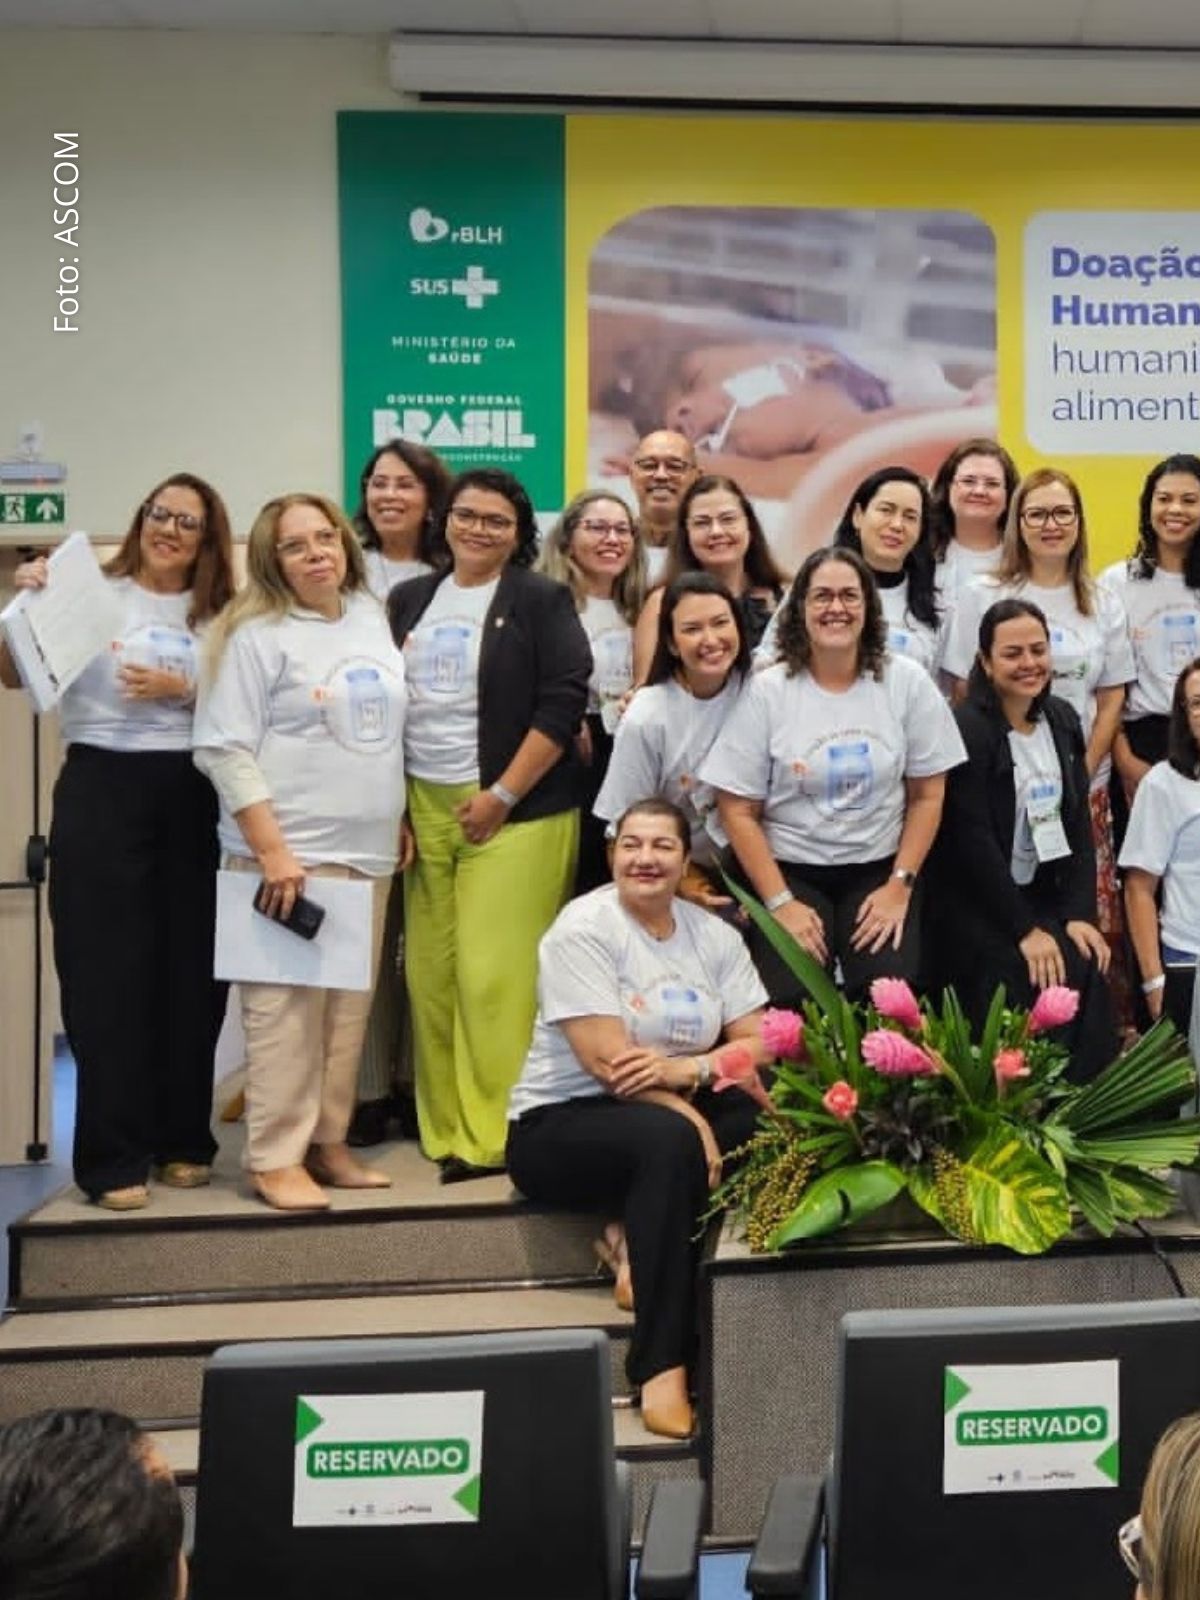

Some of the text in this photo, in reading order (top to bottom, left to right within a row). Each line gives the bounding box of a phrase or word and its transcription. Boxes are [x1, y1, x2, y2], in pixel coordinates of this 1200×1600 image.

[451, 226, 502, 244] rBLH
[410, 278, 449, 295] SUS
[494, 337, 516, 349] DA
[386, 394, 521, 406] GOVERNO FEDERAL
[372, 408, 537, 448] BRASIL
[961, 1413, 1102, 1440] RESERVADO
[314, 1446, 463, 1473] RESERVADO
